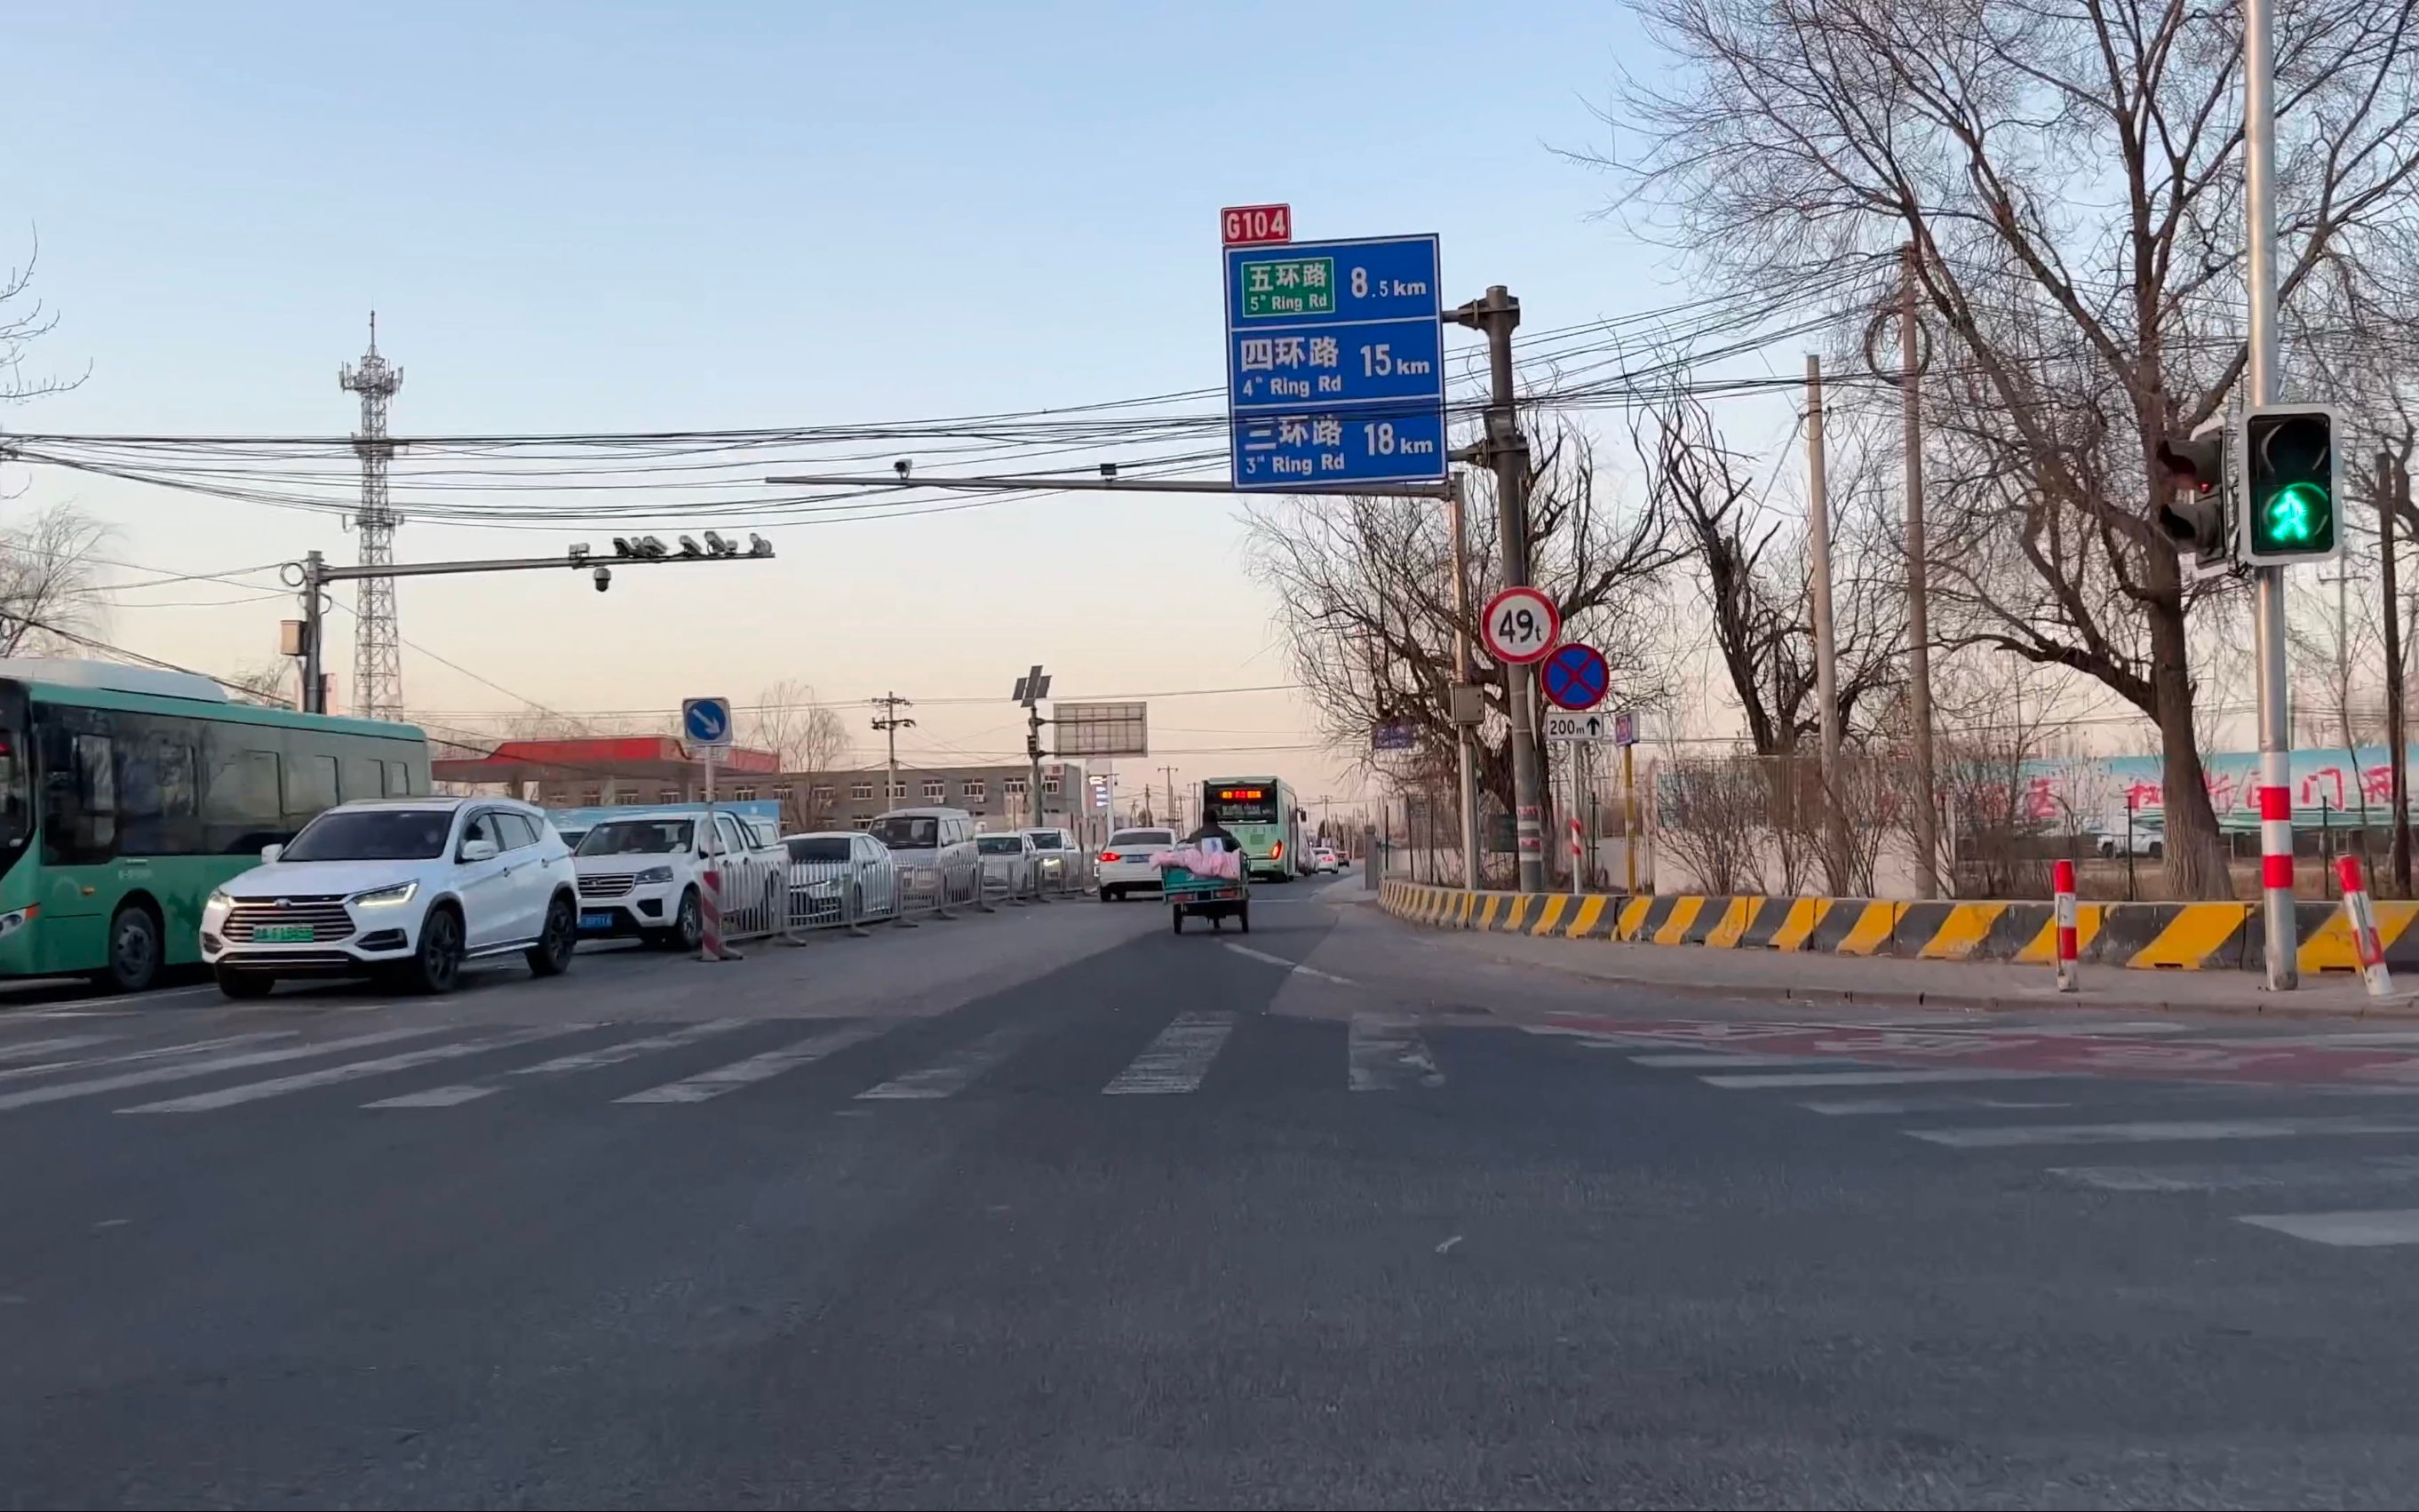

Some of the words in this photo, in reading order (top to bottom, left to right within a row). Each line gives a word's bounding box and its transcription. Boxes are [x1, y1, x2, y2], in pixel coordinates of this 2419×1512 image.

[1227, 210, 1285, 239] G104
[1249, 263, 1326, 291] 五环路
[1351, 267, 1388, 298] 8.5
[1394, 280, 1427, 297] km
[1271, 296, 1302, 312] Ring
[1309, 293, 1327, 308] Rd
[1241, 336, 1339, 372] 四环路
[1360, 344, 1391, 377] 15
[1396, 358, 1429, 375] km
[1270, 377, 1309, 397] Ring
[1318, 374, 1341, 392] Rd
[1245, 415, 1342, 450] 三环路
[1364, 423, 1395, 456] 18
[1400, 437, 1433, 454] km
[1272, 456, 1312, 475] Ring
[1321, 452, 1345, 470] Rd
[1499, 609, 1541, 643] 49t
[1549, 719, 1585, 735] 200m
